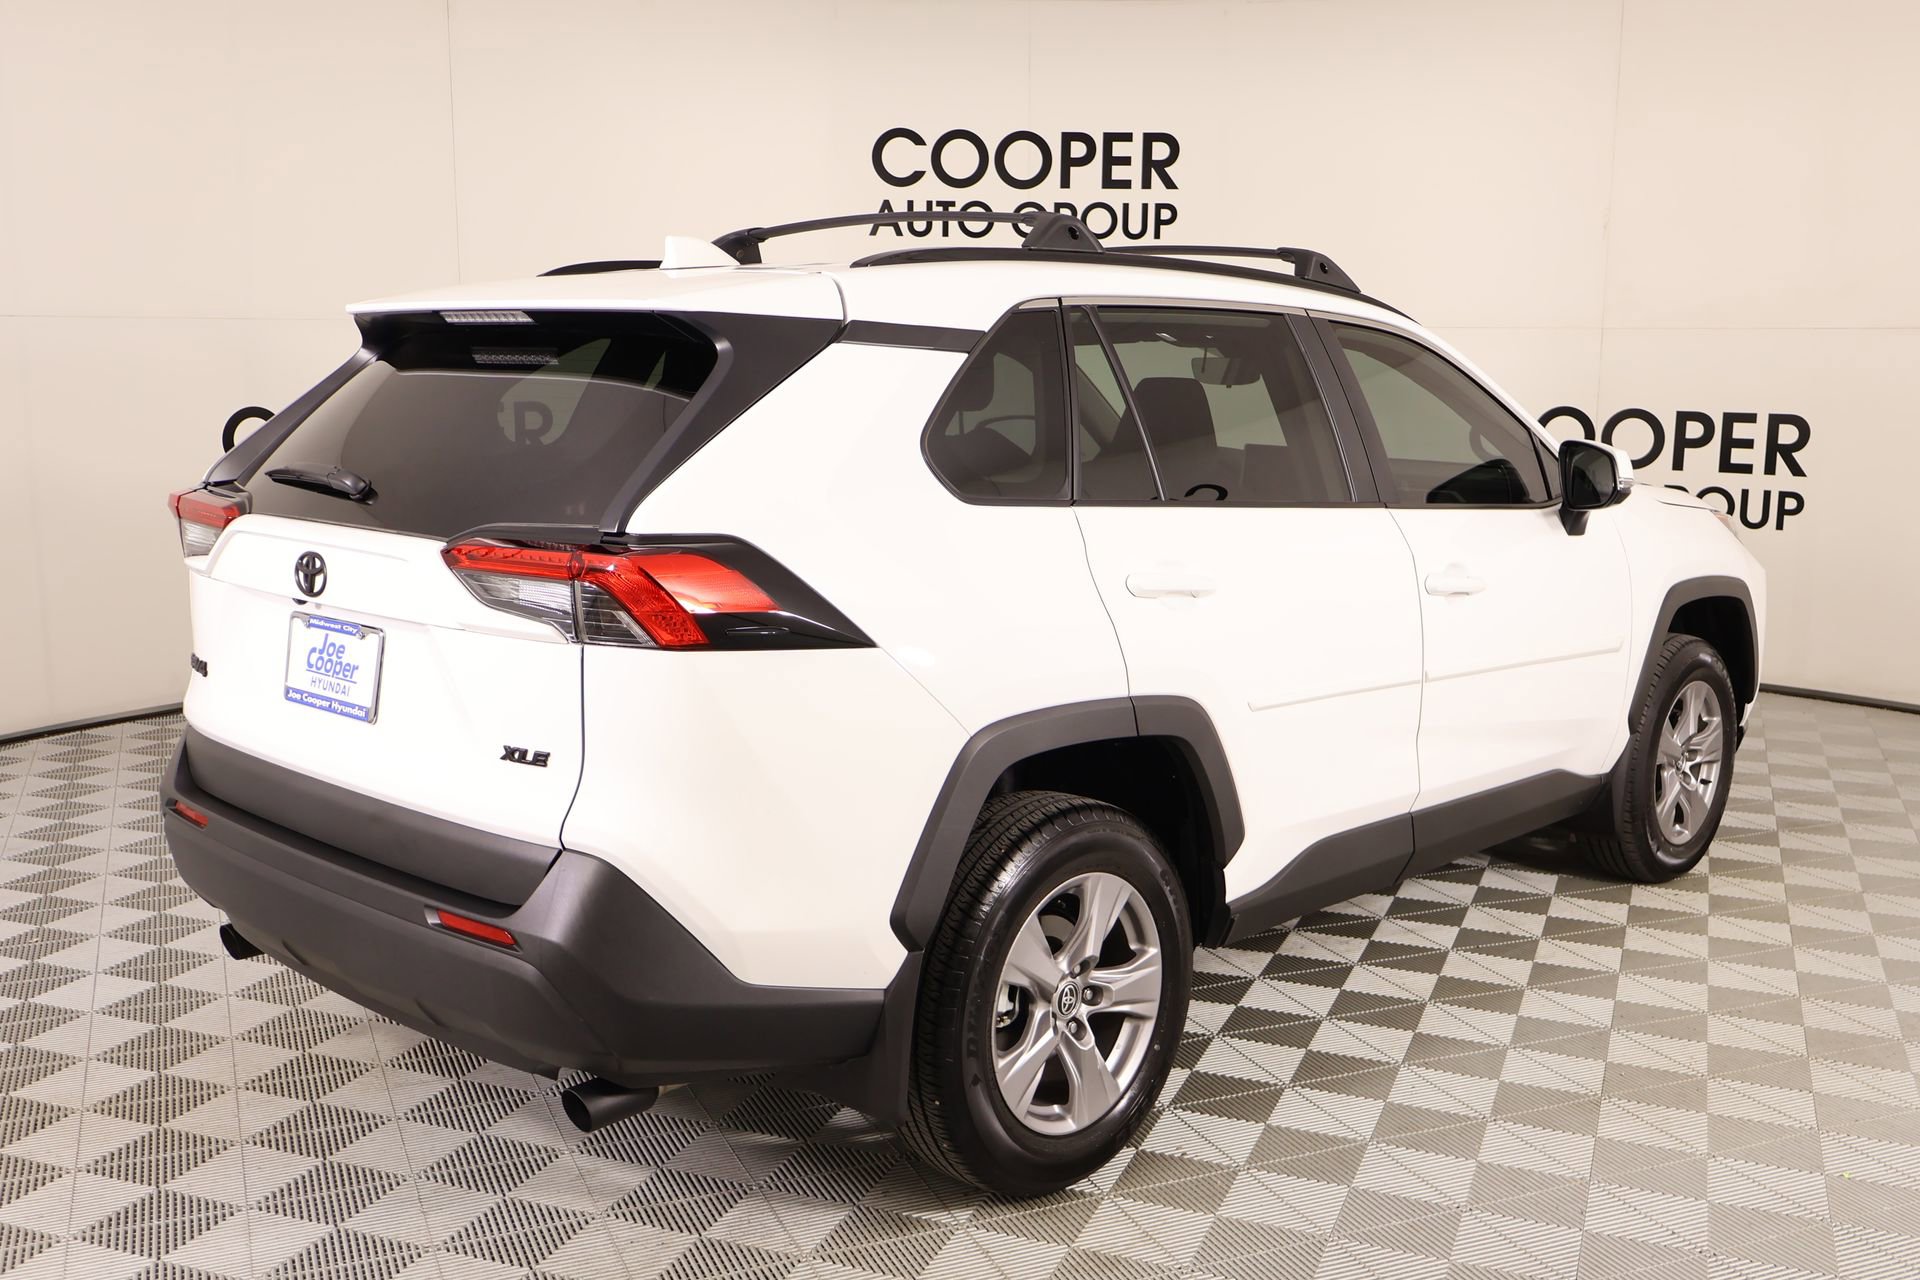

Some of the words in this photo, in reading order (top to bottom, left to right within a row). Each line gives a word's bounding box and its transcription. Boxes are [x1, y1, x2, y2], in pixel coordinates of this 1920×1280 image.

[872, 127, 1180, 190] COOPER
[869, 199, 994, 239] AUTO
[309, 618, 342, 630] Midwest
[343, 624, 358, 634] City
[318, 633, 346, 660] Joe
[306, 646, 359, 679] Cooper
[310, 676, 351, 697] HYUNDAI
[287, 689, 301, 700] Joe
[302, 693, 331, 708] Cooper
[331, 701, 366, 718] Hyundai
[499, 744, 551, 768] XLE
